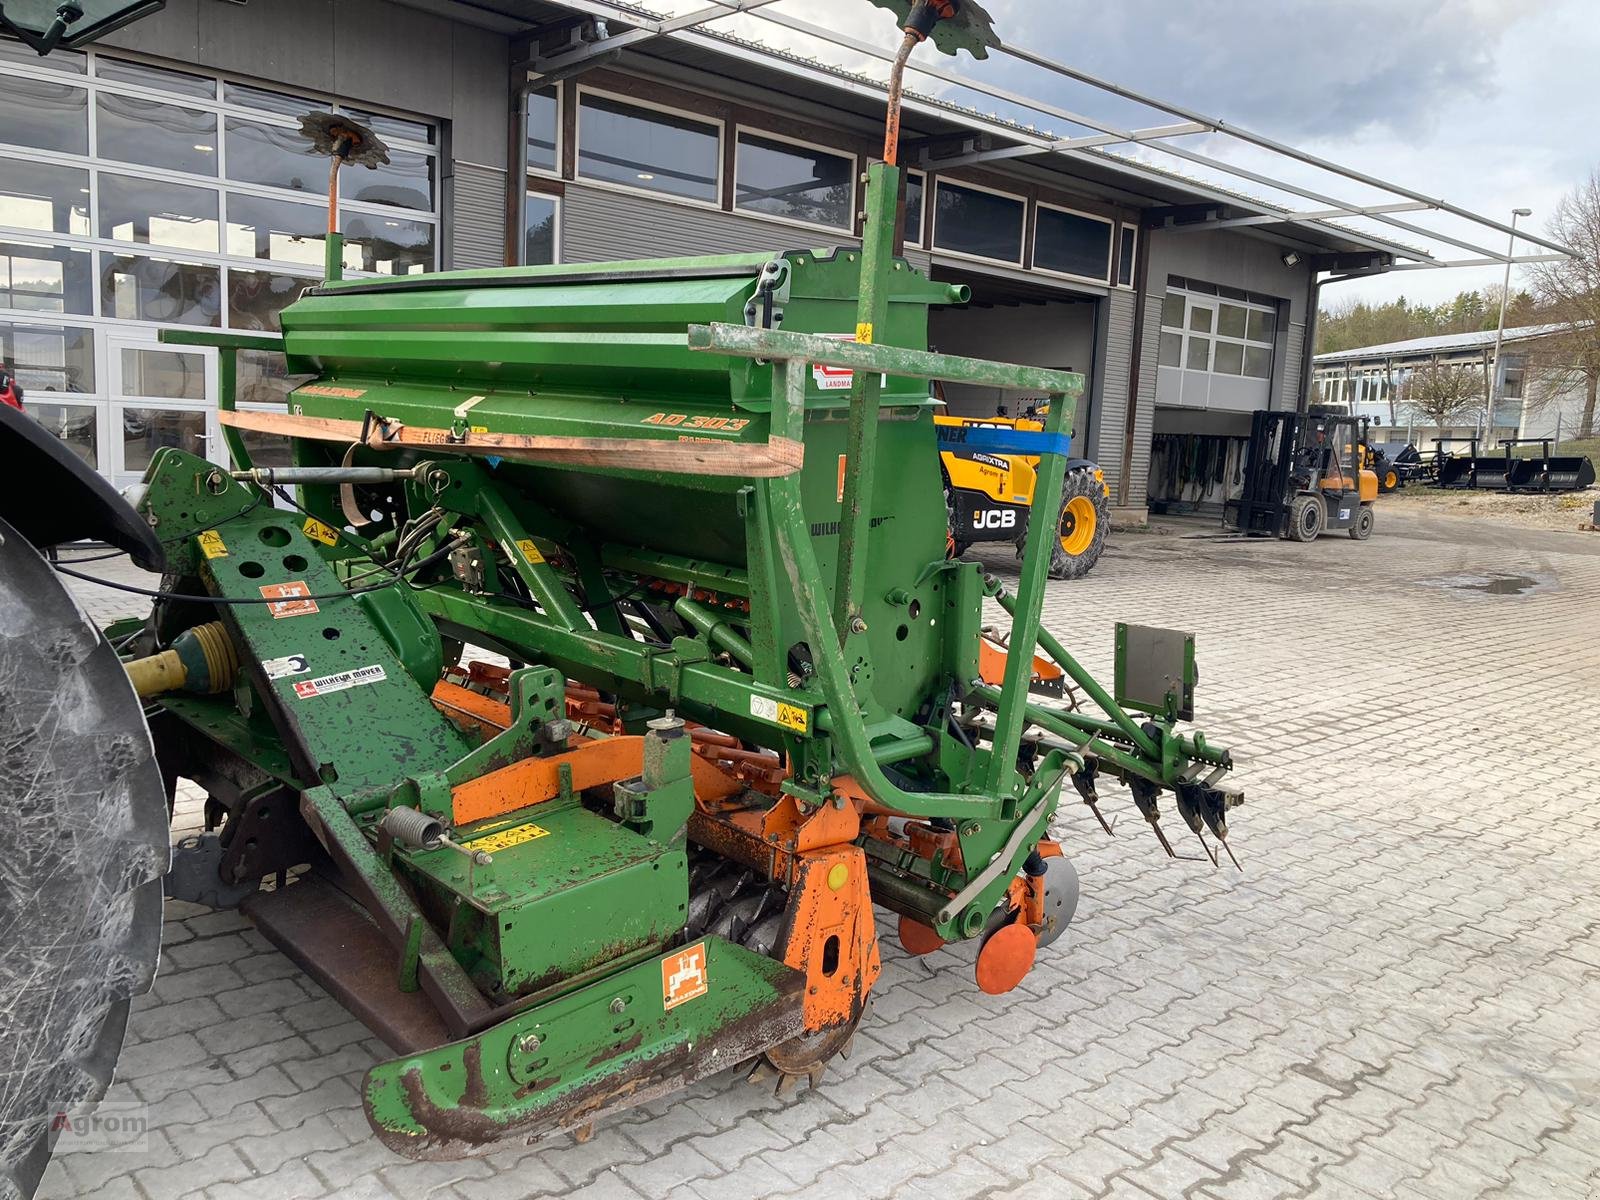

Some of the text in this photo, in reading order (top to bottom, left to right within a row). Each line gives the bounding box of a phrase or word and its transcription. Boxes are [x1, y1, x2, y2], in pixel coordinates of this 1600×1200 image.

[641, 413, 750, 431] AD 303
[972, 453, 1008, 469] AGRIXTRA
[973, 509, 1016, 529] JCB
[353, 667, 382, 679] MAYER
